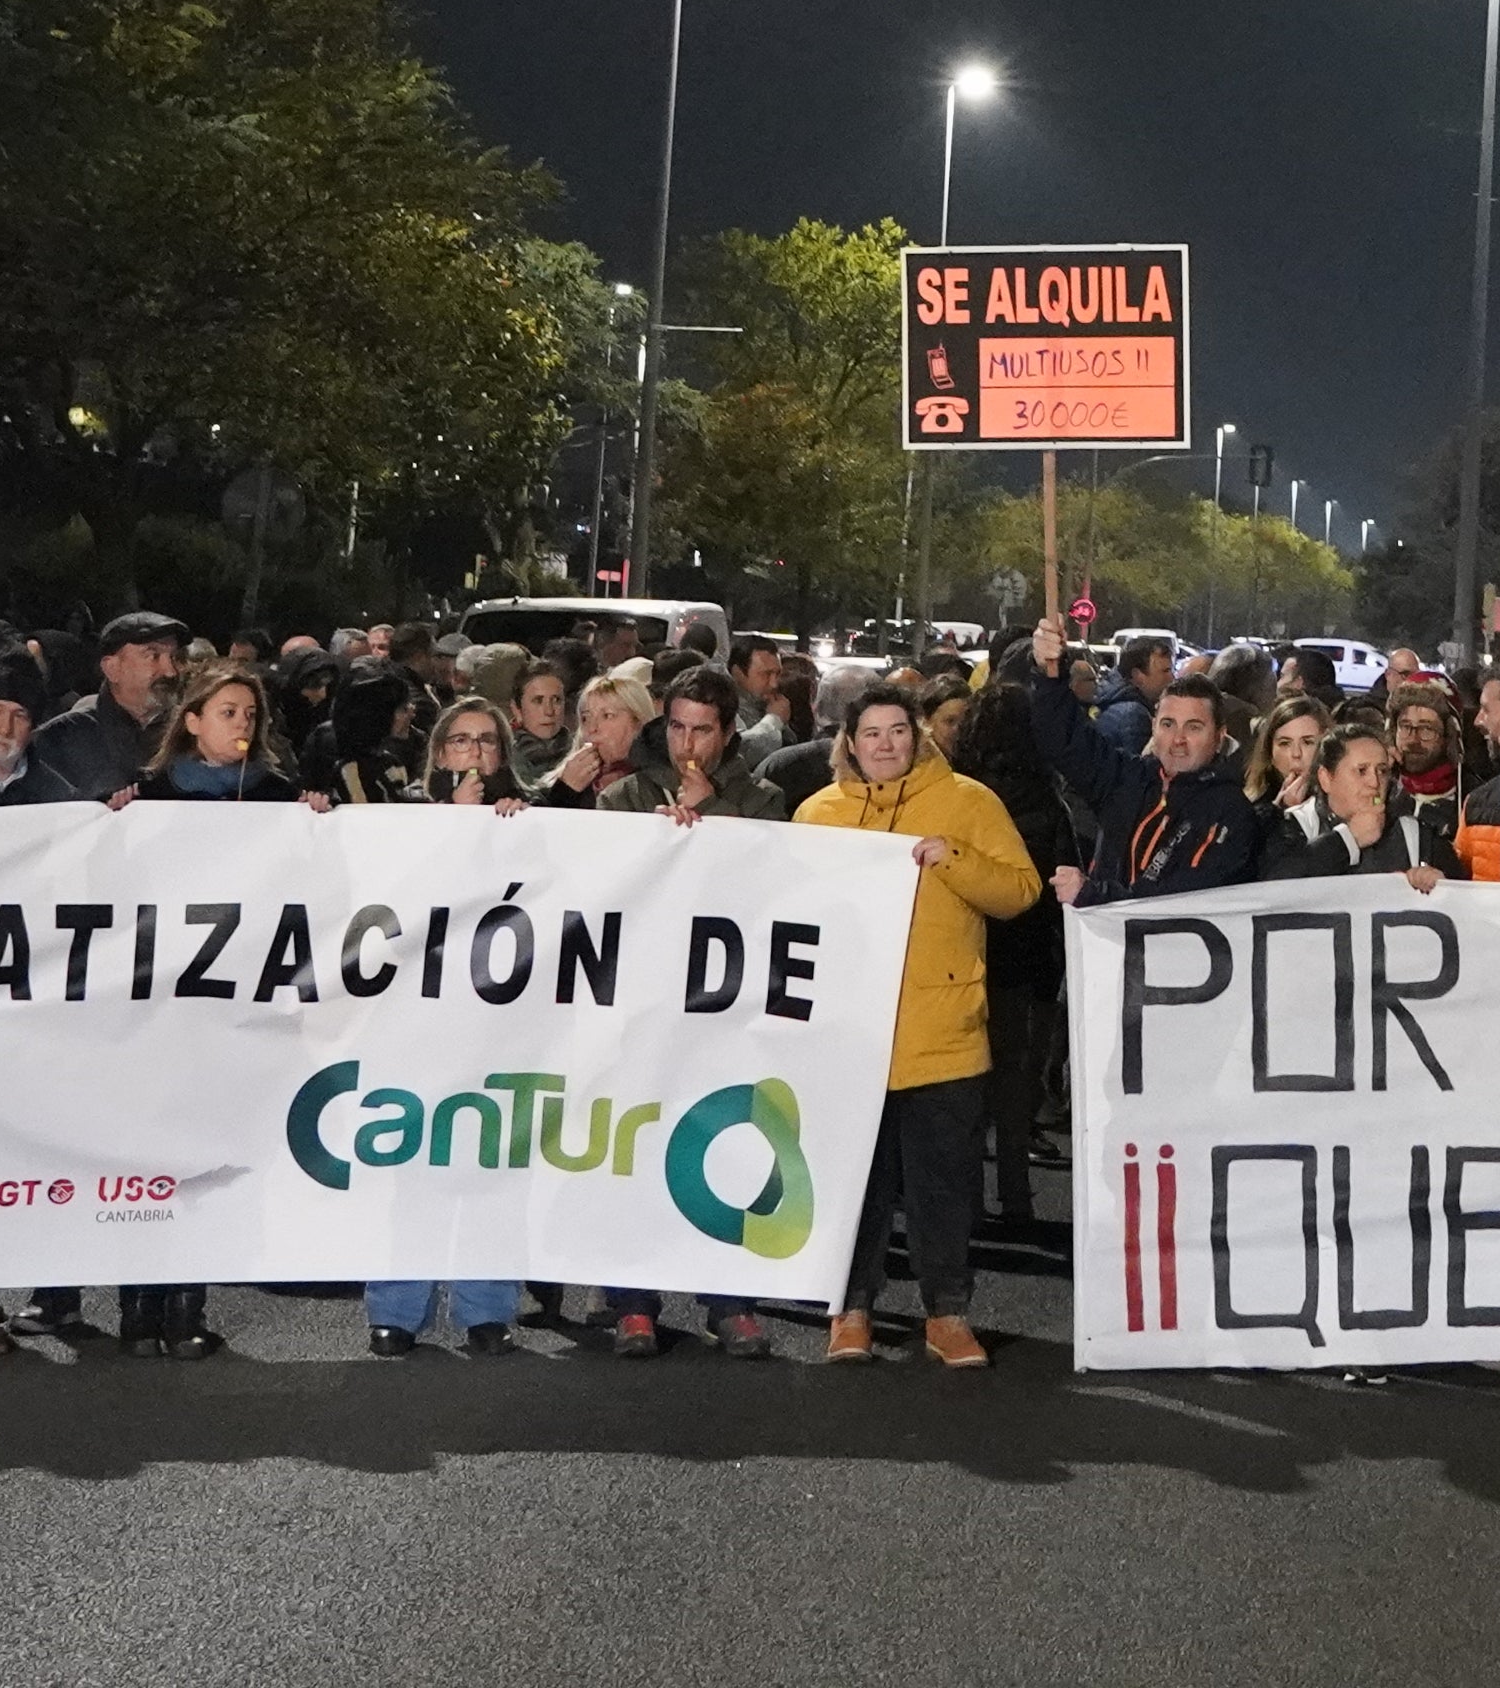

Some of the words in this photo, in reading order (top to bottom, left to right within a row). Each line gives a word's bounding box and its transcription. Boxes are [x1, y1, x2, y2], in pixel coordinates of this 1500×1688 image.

[917, 267, 971, 325] SE
[985, 265, 1173, 329] ALQUILA
[989, 348, 1125, 380] MULTIUSOS
[684, 916, 821, 1022] DE
[1121, 910, 1460, 1095] POR
[95, 1209, 175, 1224] CANTABRIA
